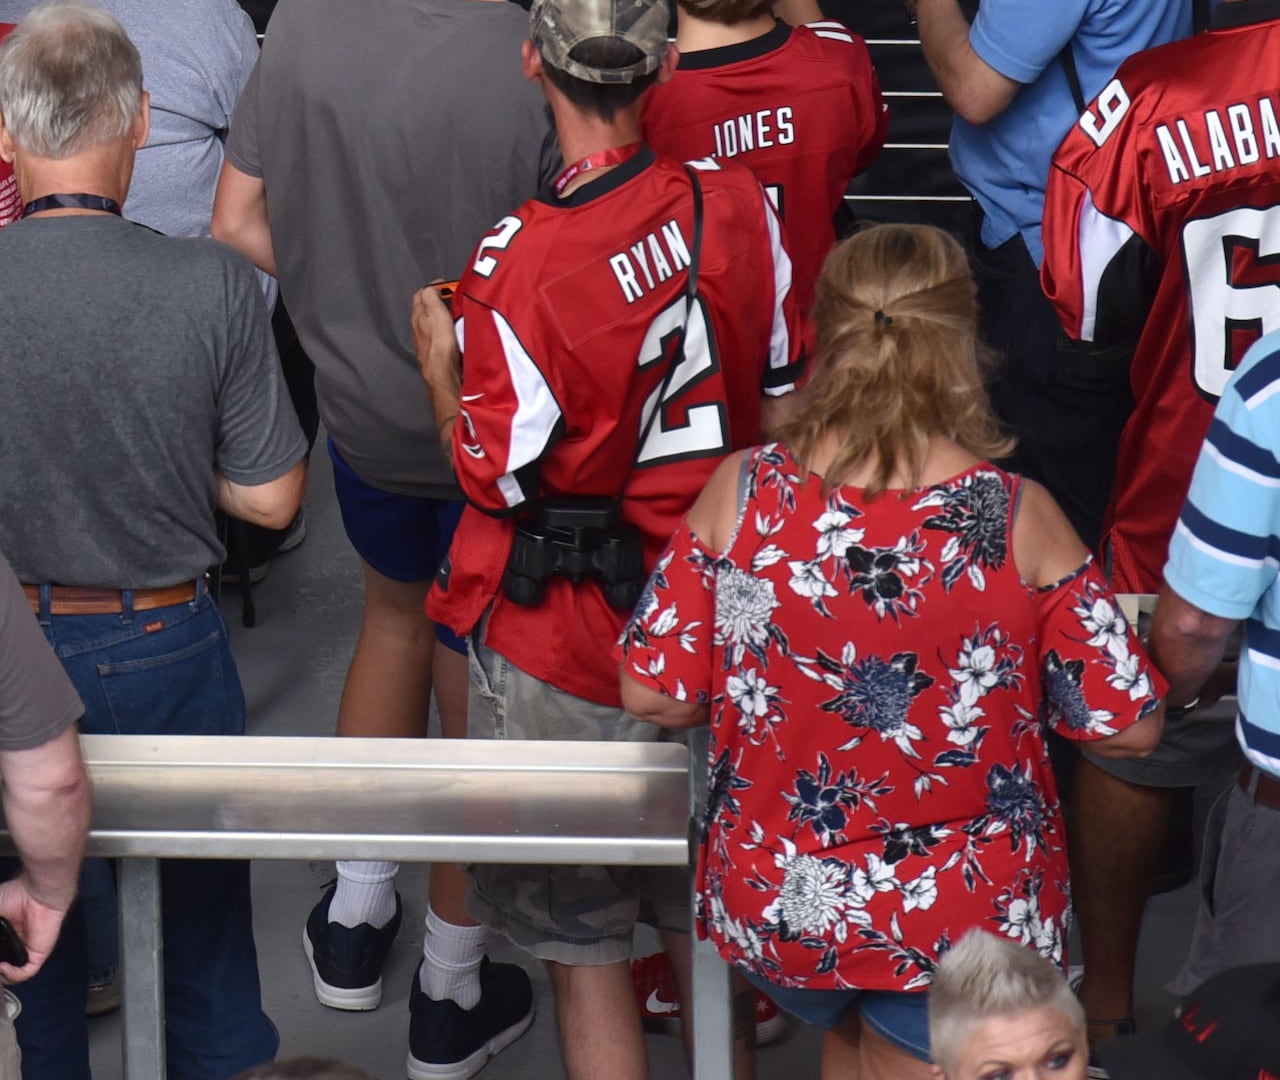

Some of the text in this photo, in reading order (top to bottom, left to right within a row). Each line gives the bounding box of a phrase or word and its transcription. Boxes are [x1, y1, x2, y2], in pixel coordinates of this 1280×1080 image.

[710, 106, 795, 160] JONES
[472, 215, 523, 280] 2
[608, 219, 692, 304] RYAN
[636, 293, 732, 469] 2
